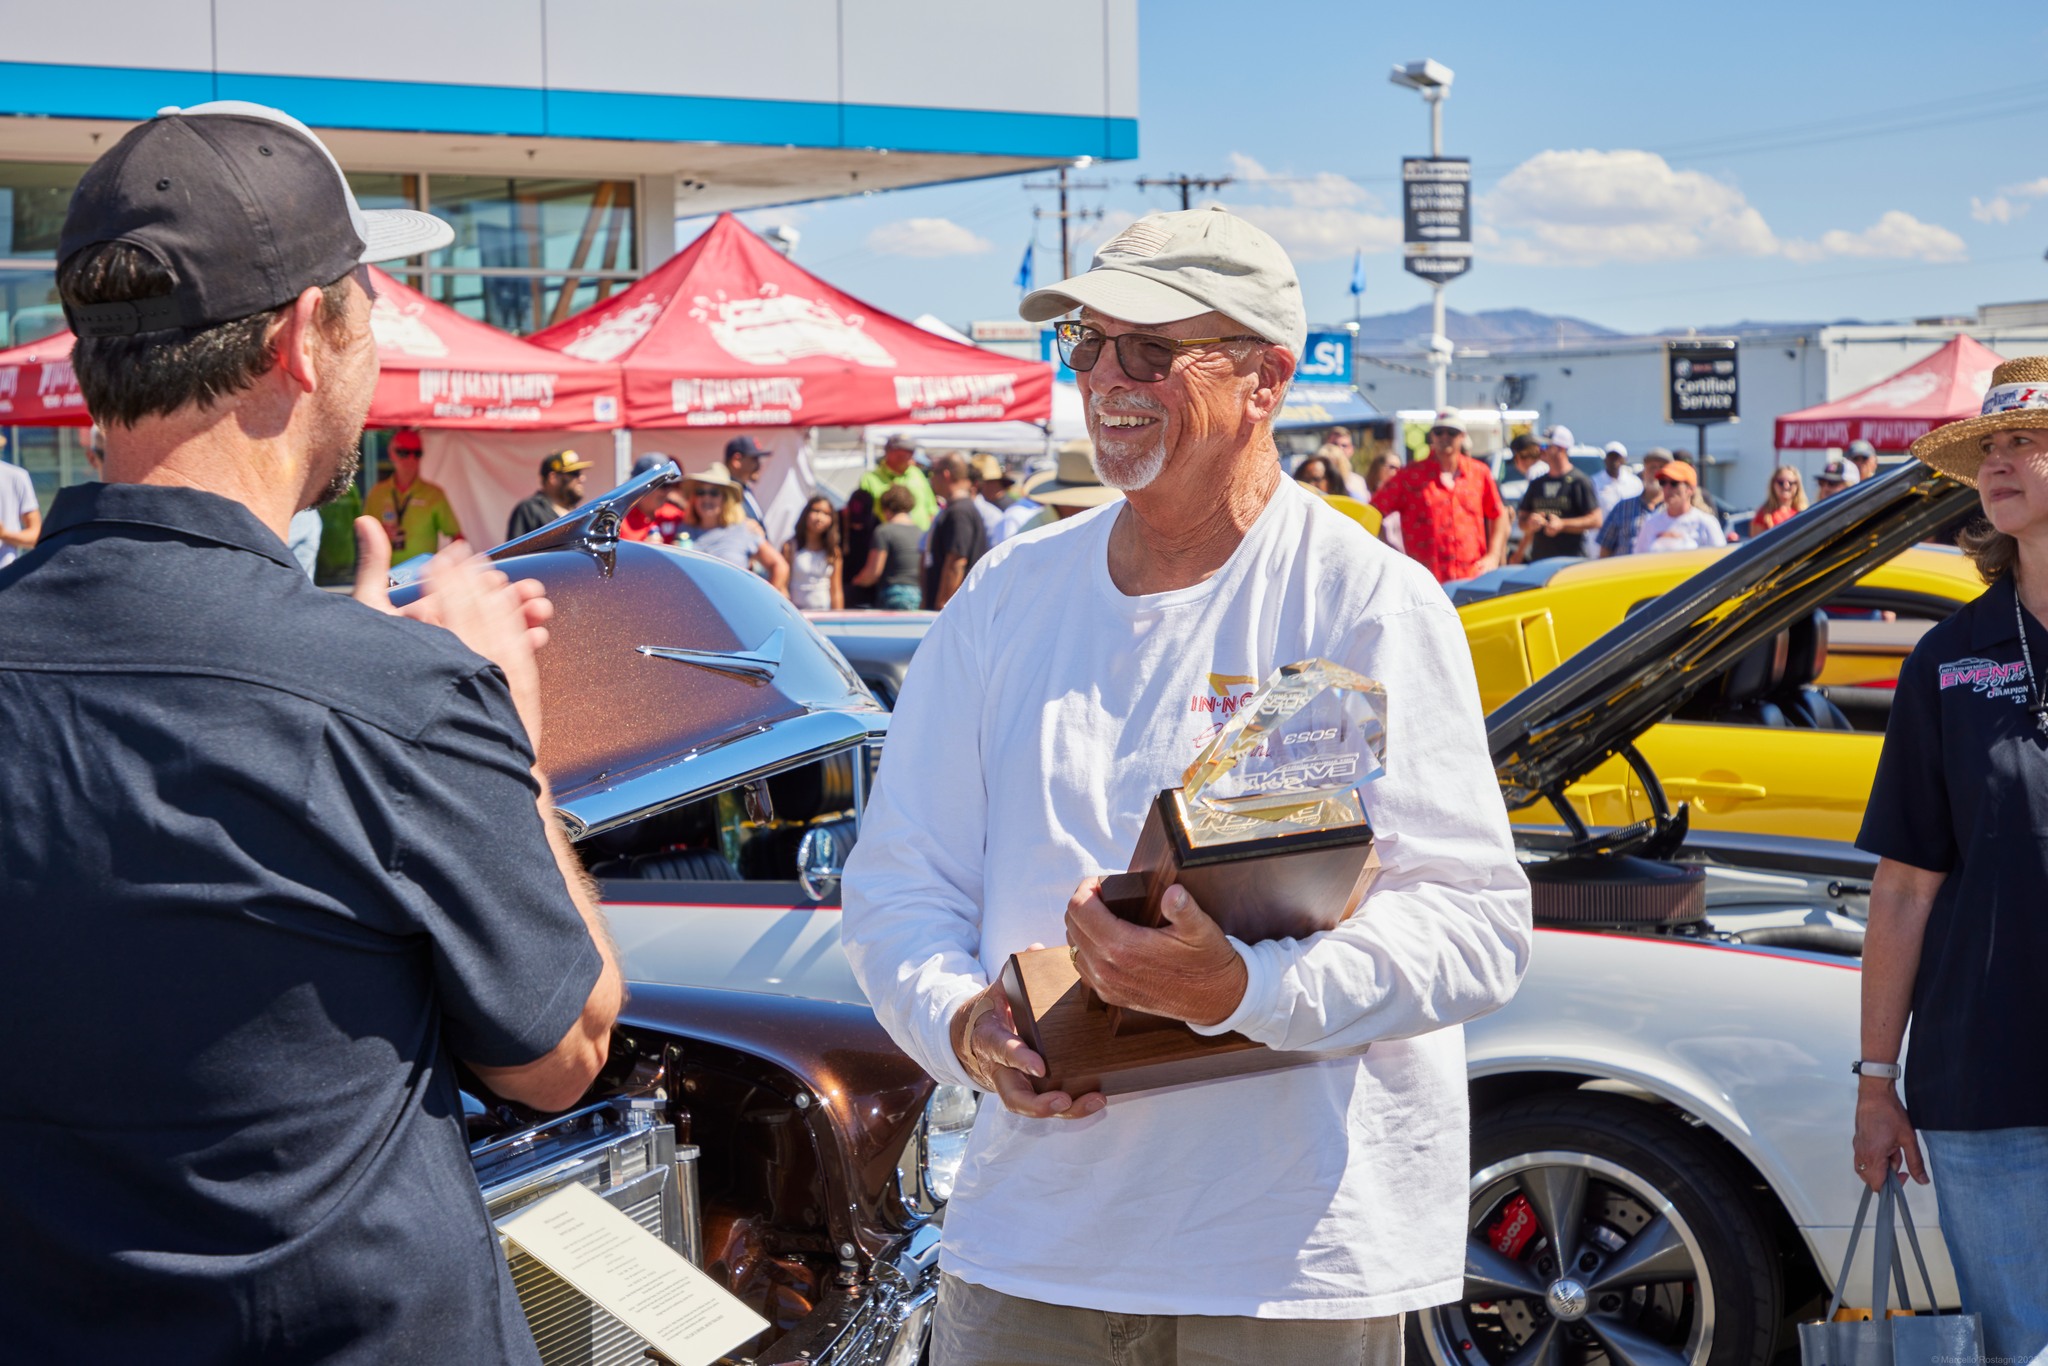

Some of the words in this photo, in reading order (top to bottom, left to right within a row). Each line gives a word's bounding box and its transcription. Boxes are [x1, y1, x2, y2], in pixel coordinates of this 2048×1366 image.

[1674, 377, 1736, 395] Certified
[1679, 394, 1732, 410] Service
[1940, 661, 2026, 690] EVENT
[1973, 668, 2028, 692] Series
